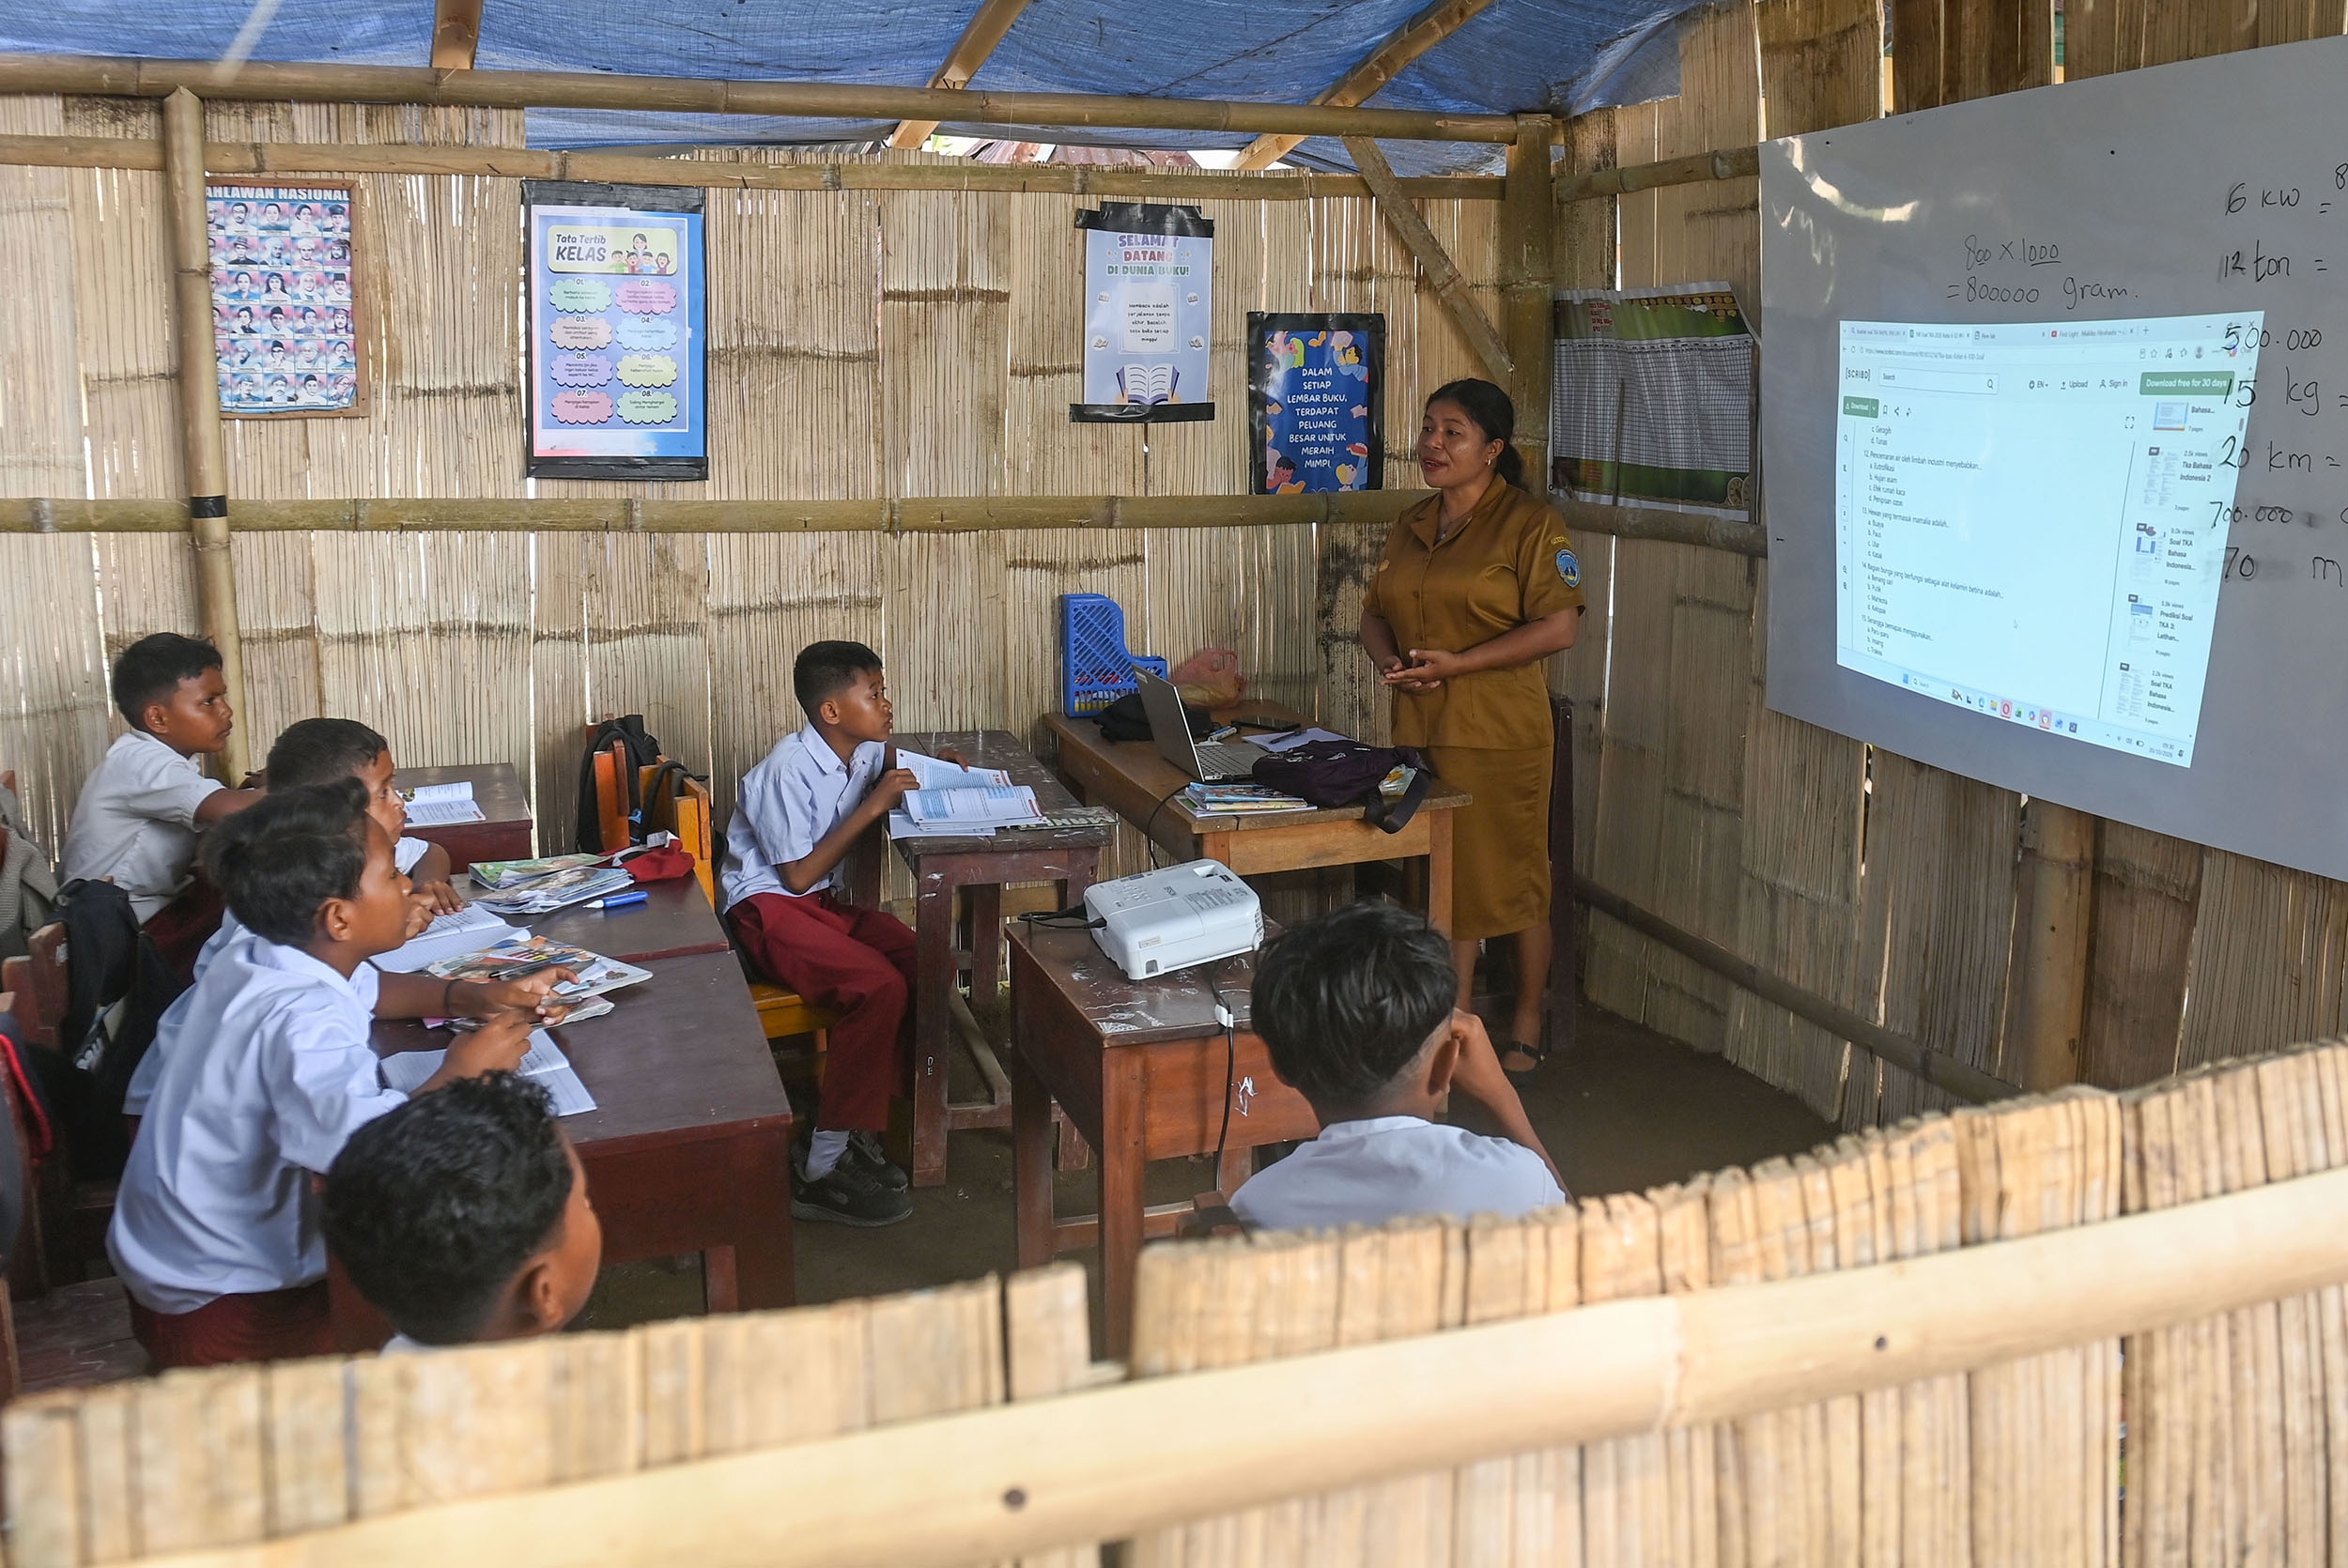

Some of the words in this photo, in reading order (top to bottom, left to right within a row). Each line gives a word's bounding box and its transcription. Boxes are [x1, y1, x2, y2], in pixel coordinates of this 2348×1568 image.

[206, 186, 275, 199] AHLAWAN
[278, 188, 351, 201] NASIONAL
[556, 234, 577, 243] Tata
[579, 234, 607, 245] Tertib
[556, 246, 607, 262] KELAS
[2253, 239, 2291, 283] ton
[1107, 265, 1118, 275] DI
[1122, 265, 1155, 275] DUNIA
[1158, 266, 1189, 276] BUKU!
[1302, 367, 1333, 377] DALAM
[1303, 380, 1332, 390] SETIAP
[2069, 380, 2088, 389] Upload
[2109, 380, 2121, 388] Sign
[2146, 379, 2177, 387] Download
[2178, 379, 2190, 387] free
[2192, 379, 2201, 387] for
[2202, 379, 2211, 387] 30
[2285, 366, 2320, 416] kg
[1287, 394, 1321, 404] LEMBAR
[1295, 407, 1339, 417] TERDAPAT
[1298, 420, 1337, 430] PELUANG
[1289, 434, 1316, 443] BESAR
[1318, 433, 1347, 442] UNTUK
[1301, 446, 1334, 455] MERAIH
[2268, 440, 2312, 473] km
[2180, 473, 2206, 482] Indonesia
